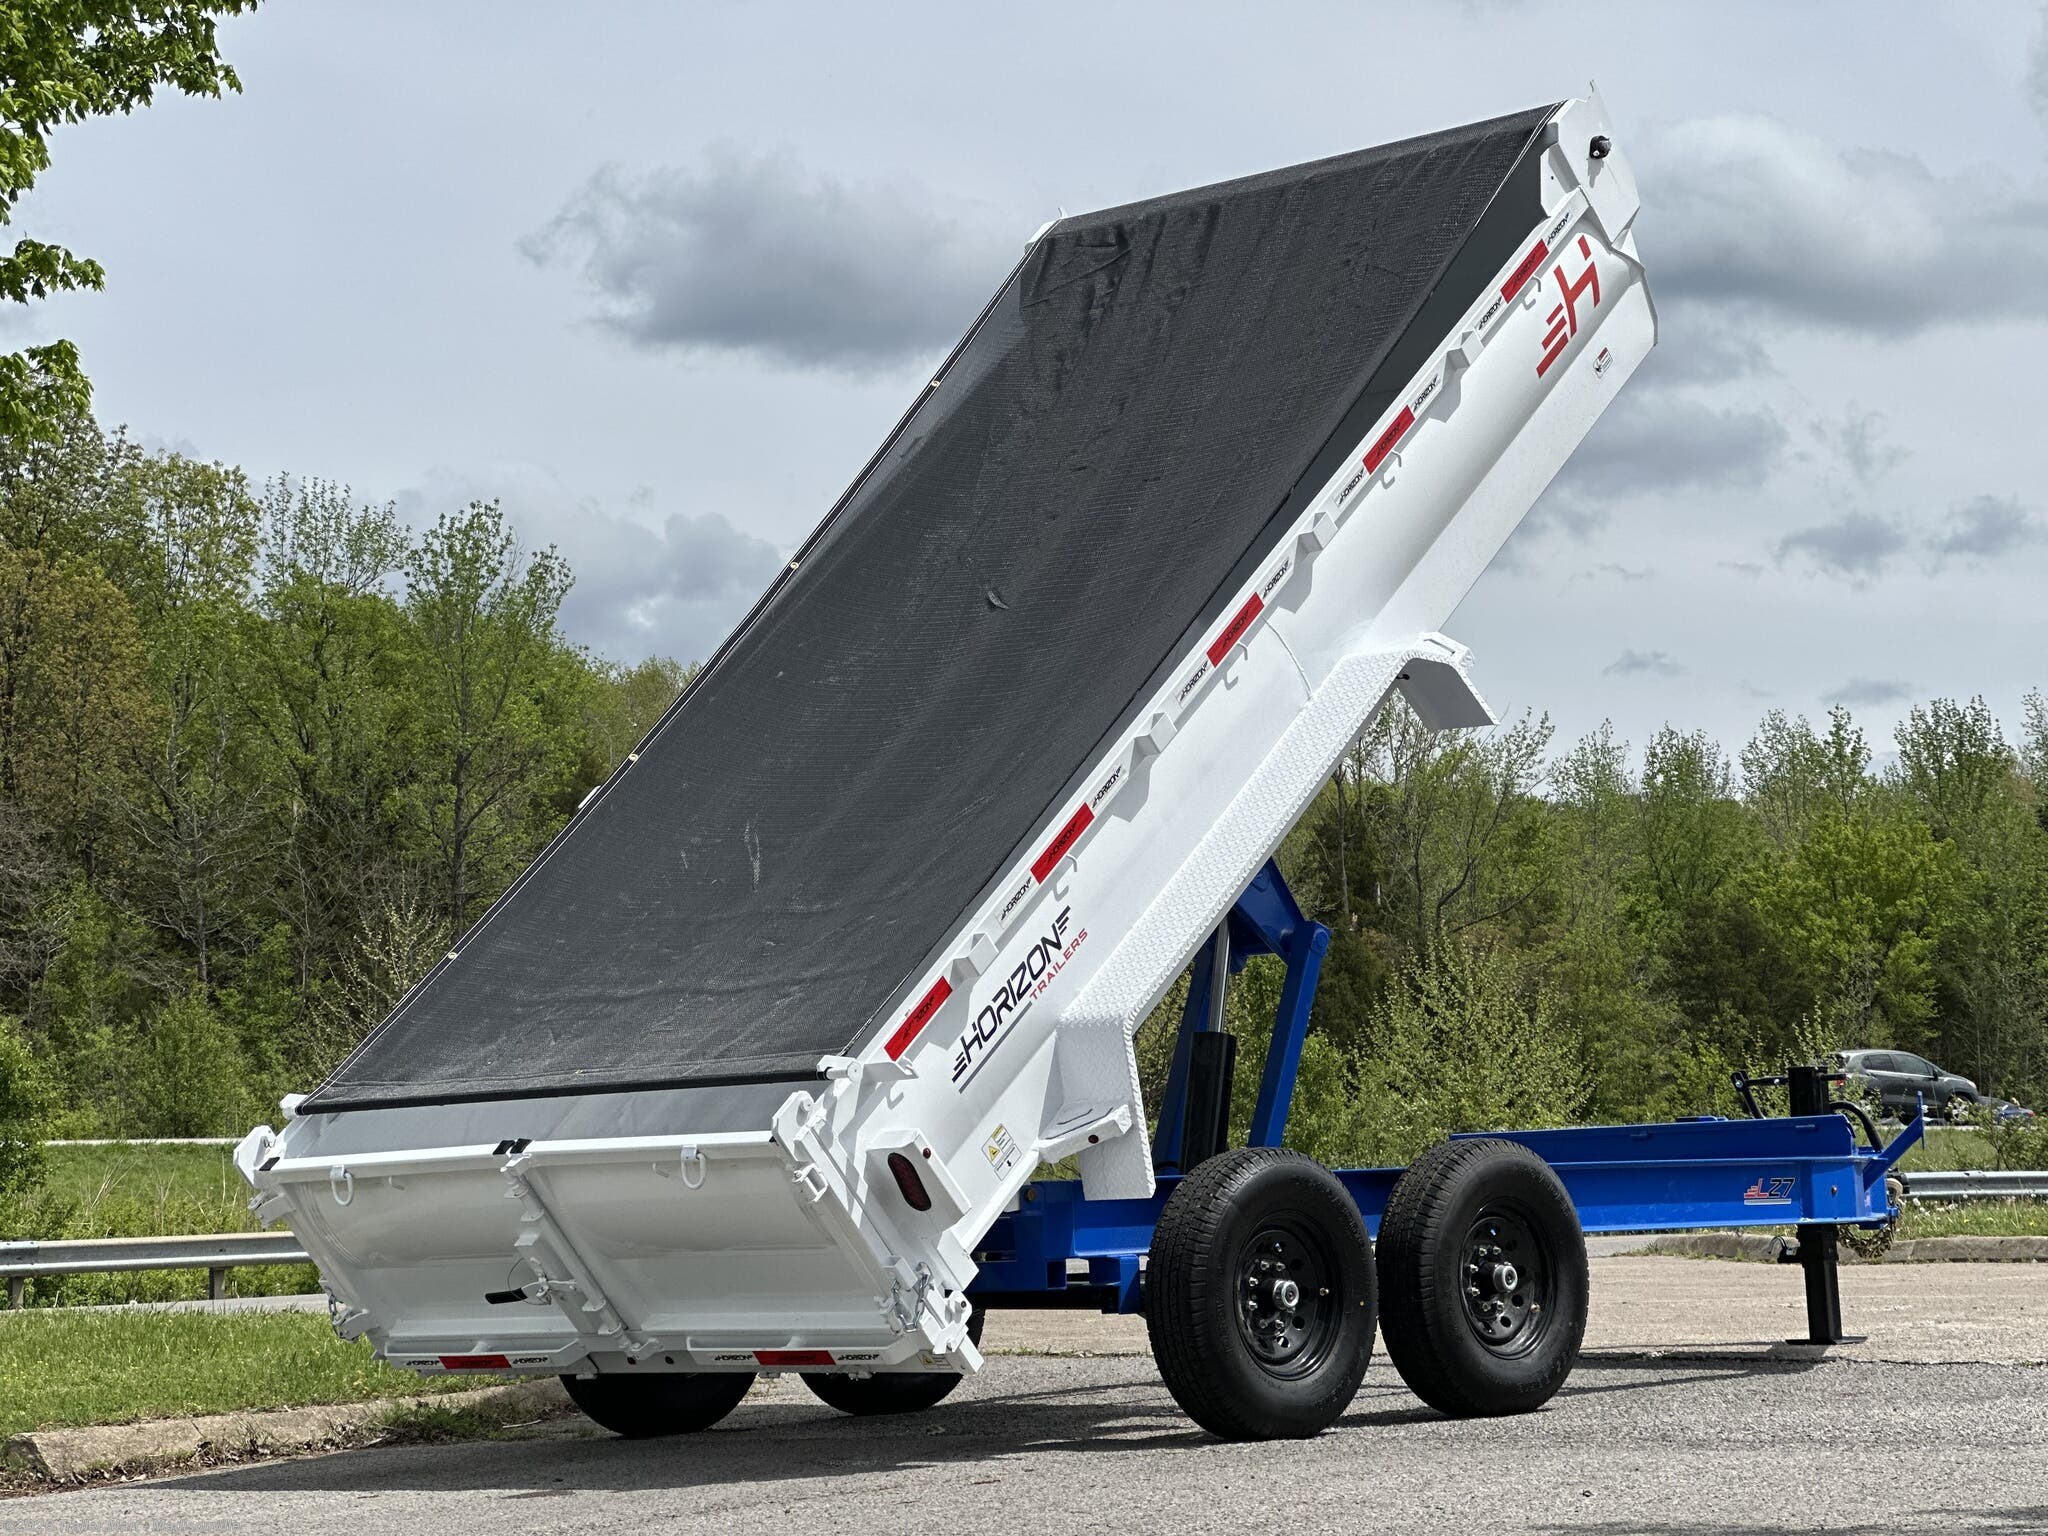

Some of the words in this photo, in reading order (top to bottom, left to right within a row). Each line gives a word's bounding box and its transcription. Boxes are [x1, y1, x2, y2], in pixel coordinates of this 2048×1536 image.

[1180, 660, 1208, 701] HORIZON
[1092, 766, 1121, 808] HORIZON
[1001, 876, 1032, 920] HORIZON
[1030, 928, 1088, 1000] TRAILERS
[952, 906, 1071, 1083] HORIZON
